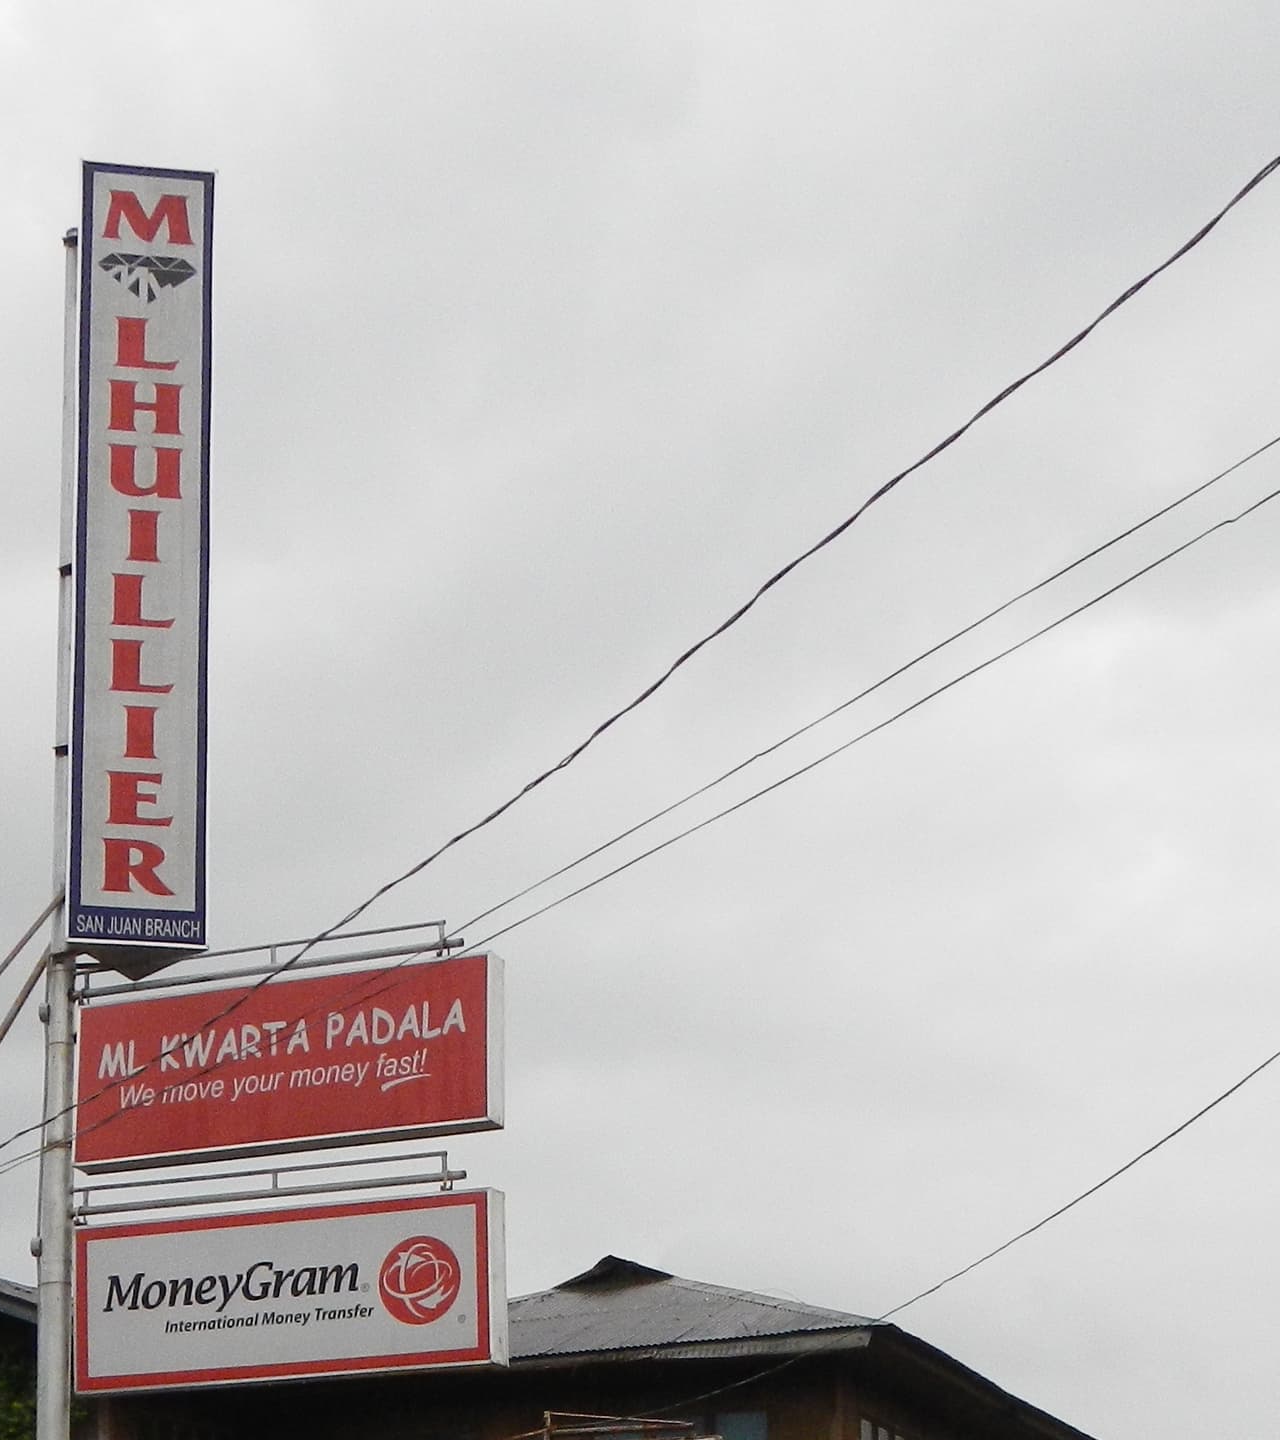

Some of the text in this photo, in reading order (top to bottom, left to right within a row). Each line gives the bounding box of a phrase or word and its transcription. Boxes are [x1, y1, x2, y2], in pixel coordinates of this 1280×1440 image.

[101, 315, 185, 898] LHUILLIER
[76, 914, 201, 940] SAN JUAN BRANCH
[97, 998, 466, 1079] ML KWARTA PADALA
[120, 1047, 428, 1109] We move your money fast!
[103, 1261, 360, 1313] MoneyGram
[164, 1304, 375, 1333] International Money Transfer
